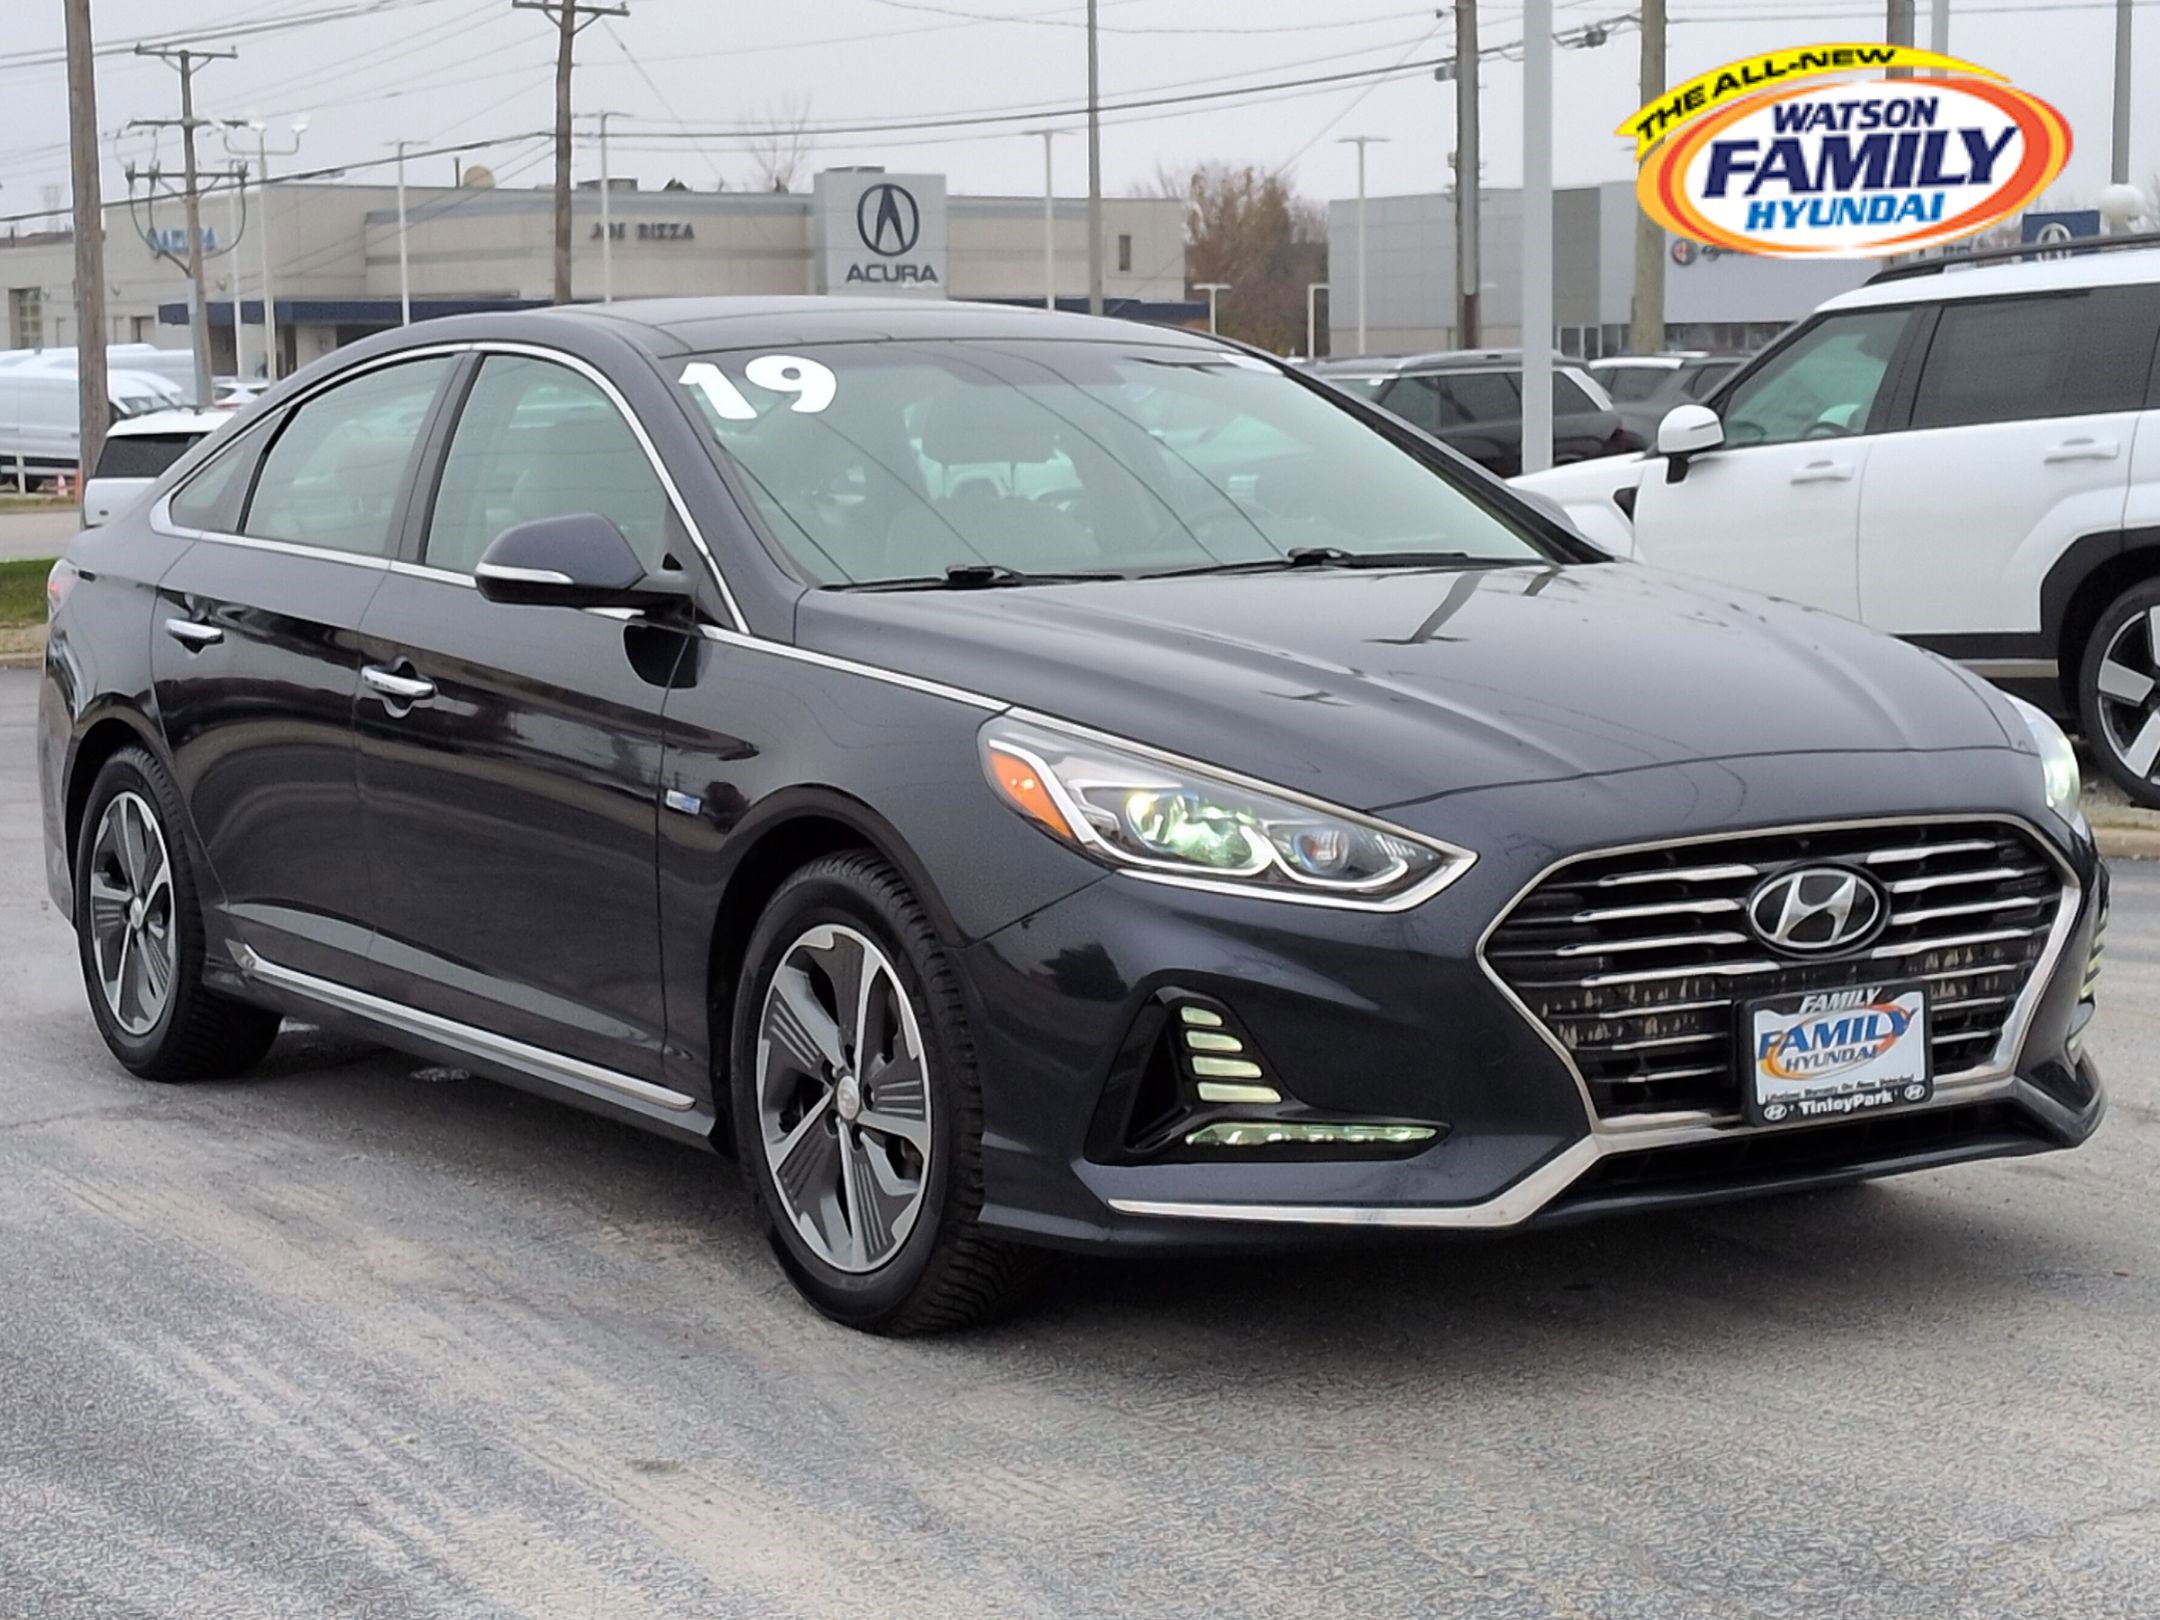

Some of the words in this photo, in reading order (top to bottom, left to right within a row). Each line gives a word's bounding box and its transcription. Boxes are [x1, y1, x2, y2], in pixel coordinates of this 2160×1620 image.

[845, 263, 939, 283] ACURA
[678, 354, 838, 420] 19
[1799, 986, 1883, 1014] FAMILY
[1758, 1007, 1921, 1061] FAMILY
[1784, 1044, 1877, 1073] HYUNDAI
